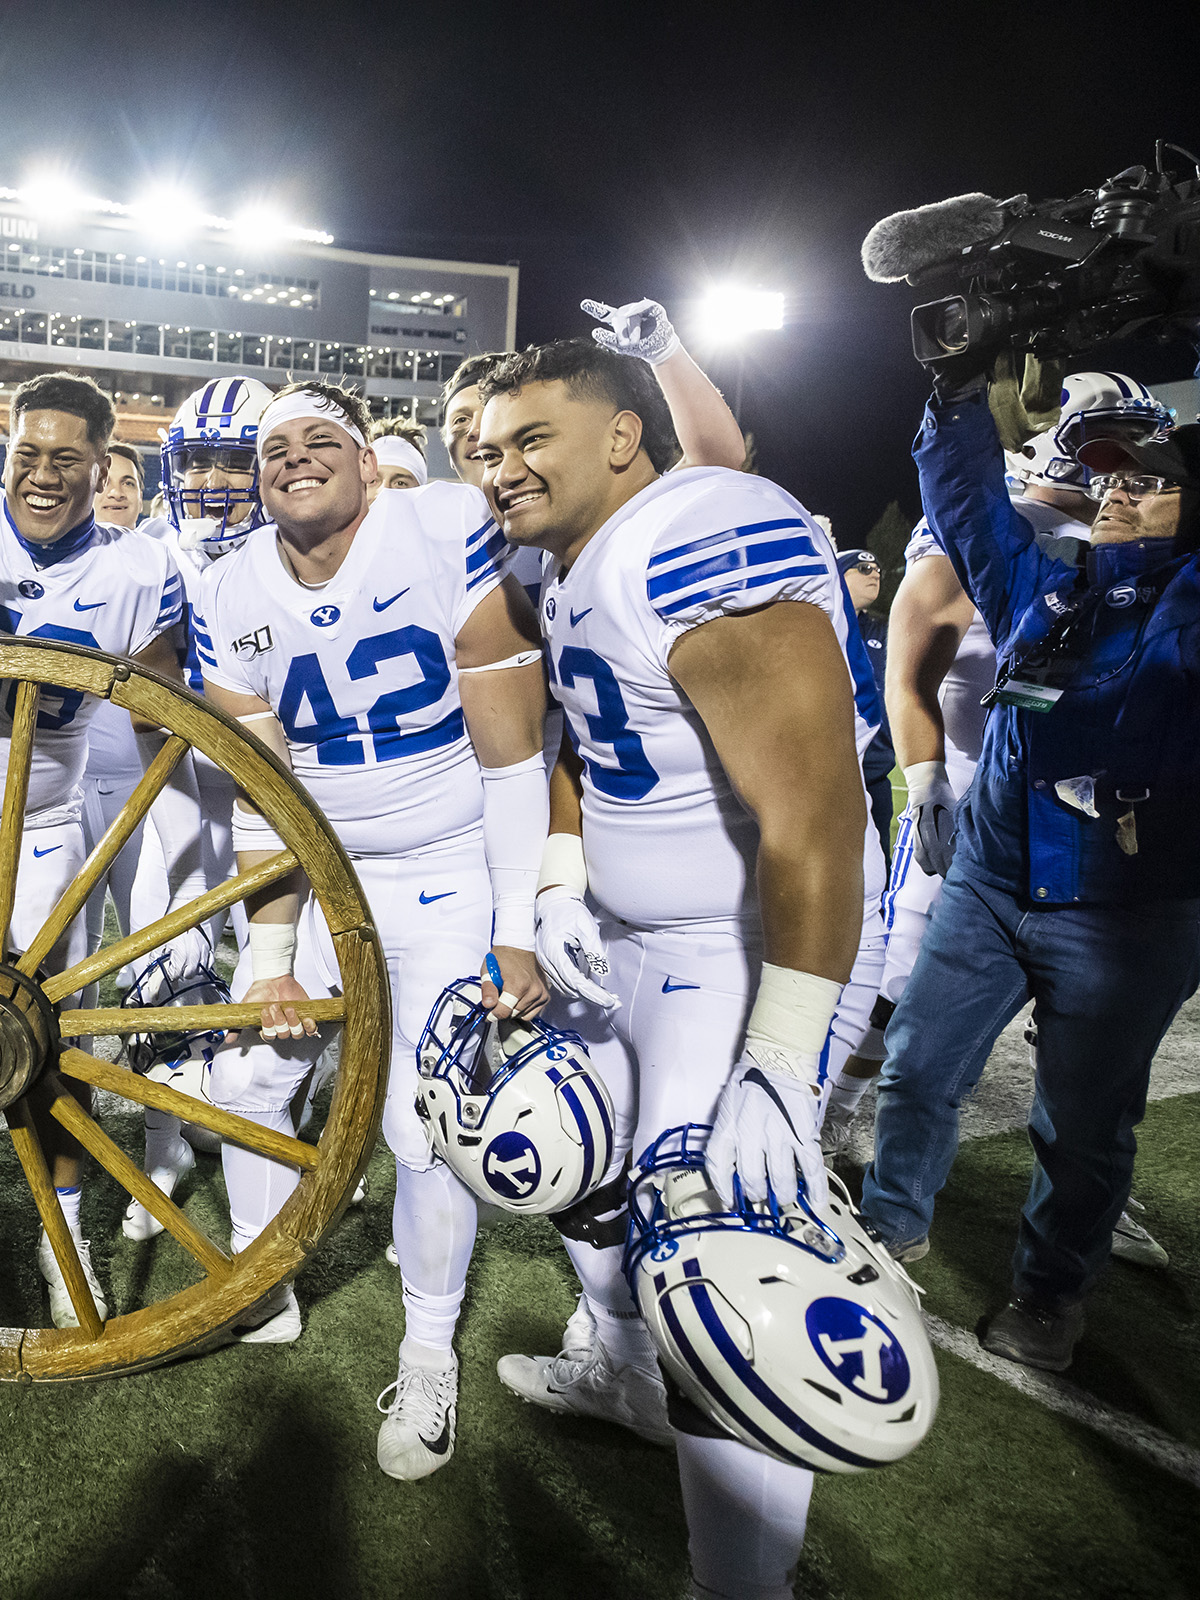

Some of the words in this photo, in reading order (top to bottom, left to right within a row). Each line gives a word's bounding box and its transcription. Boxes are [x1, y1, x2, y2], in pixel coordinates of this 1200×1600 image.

[20, 580, 44, 599] Y
[1110, 588, 1134, 605] 5
[311, 606, 339, 625] Y
[231, 625, 274, 660] 150
[278, 624, 465, 765] 42
[542, 637, 660, 800] 3
[486, 1146, 537, 1196] Y
[653, 1241, 675, 1261] Y
[816, 1313, 894, 1401] Y
